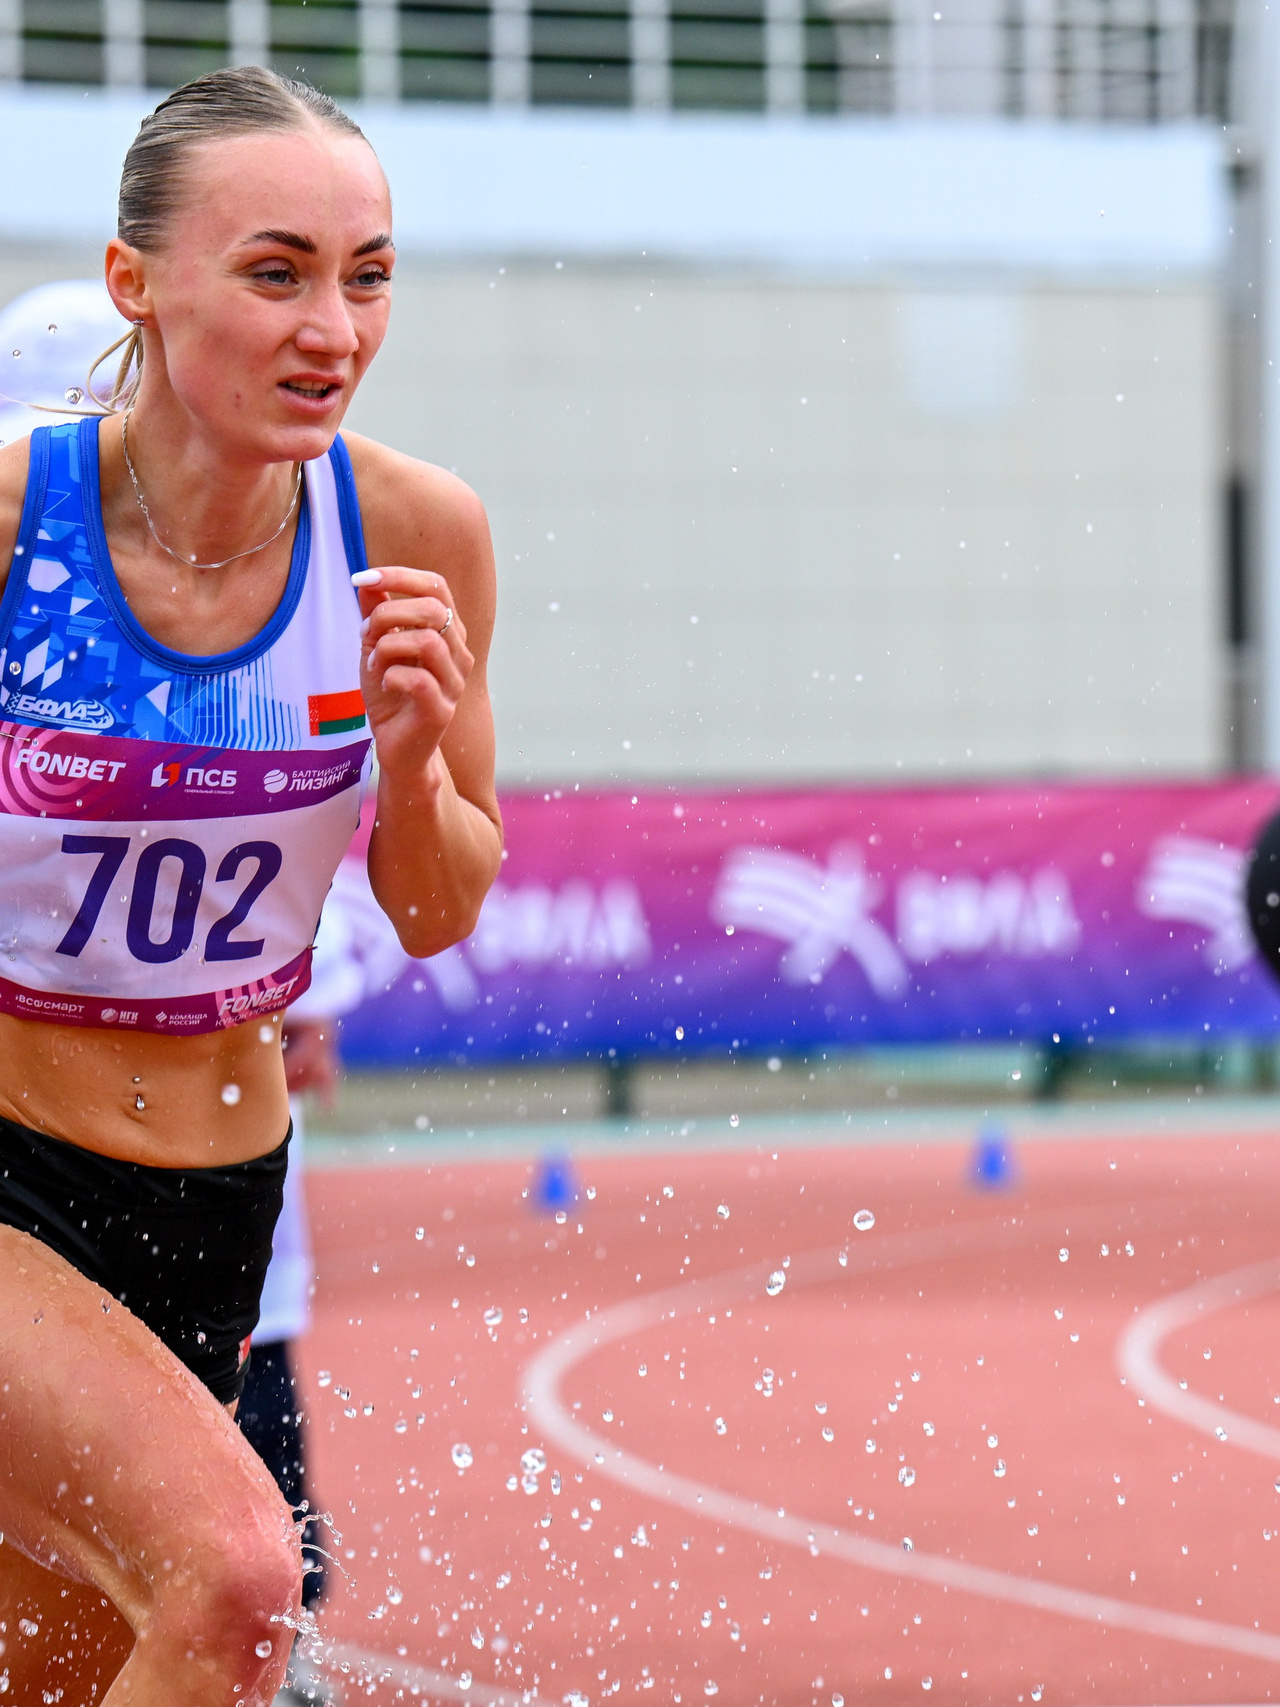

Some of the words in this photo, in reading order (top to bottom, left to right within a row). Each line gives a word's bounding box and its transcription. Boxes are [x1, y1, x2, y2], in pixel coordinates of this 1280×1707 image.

[16, 694, 88, 720] БФЛА
[14, 748, 127, 783] FONBET
[185, 768, 238, 788] ПСБ
[292, 760, 352, 778] БАЛТИЙСКИЙ
[288, 768, 349, 792] ЛИЗИНГ
[55, 834, 283, 964] 702
[218, 976, 299, 1017] FONBET
[119, 1010, 139, 1021] НГК
[215, 1013, 248, 1027] КУБОК
[249, 998, 288, 1017] РОССИИ
